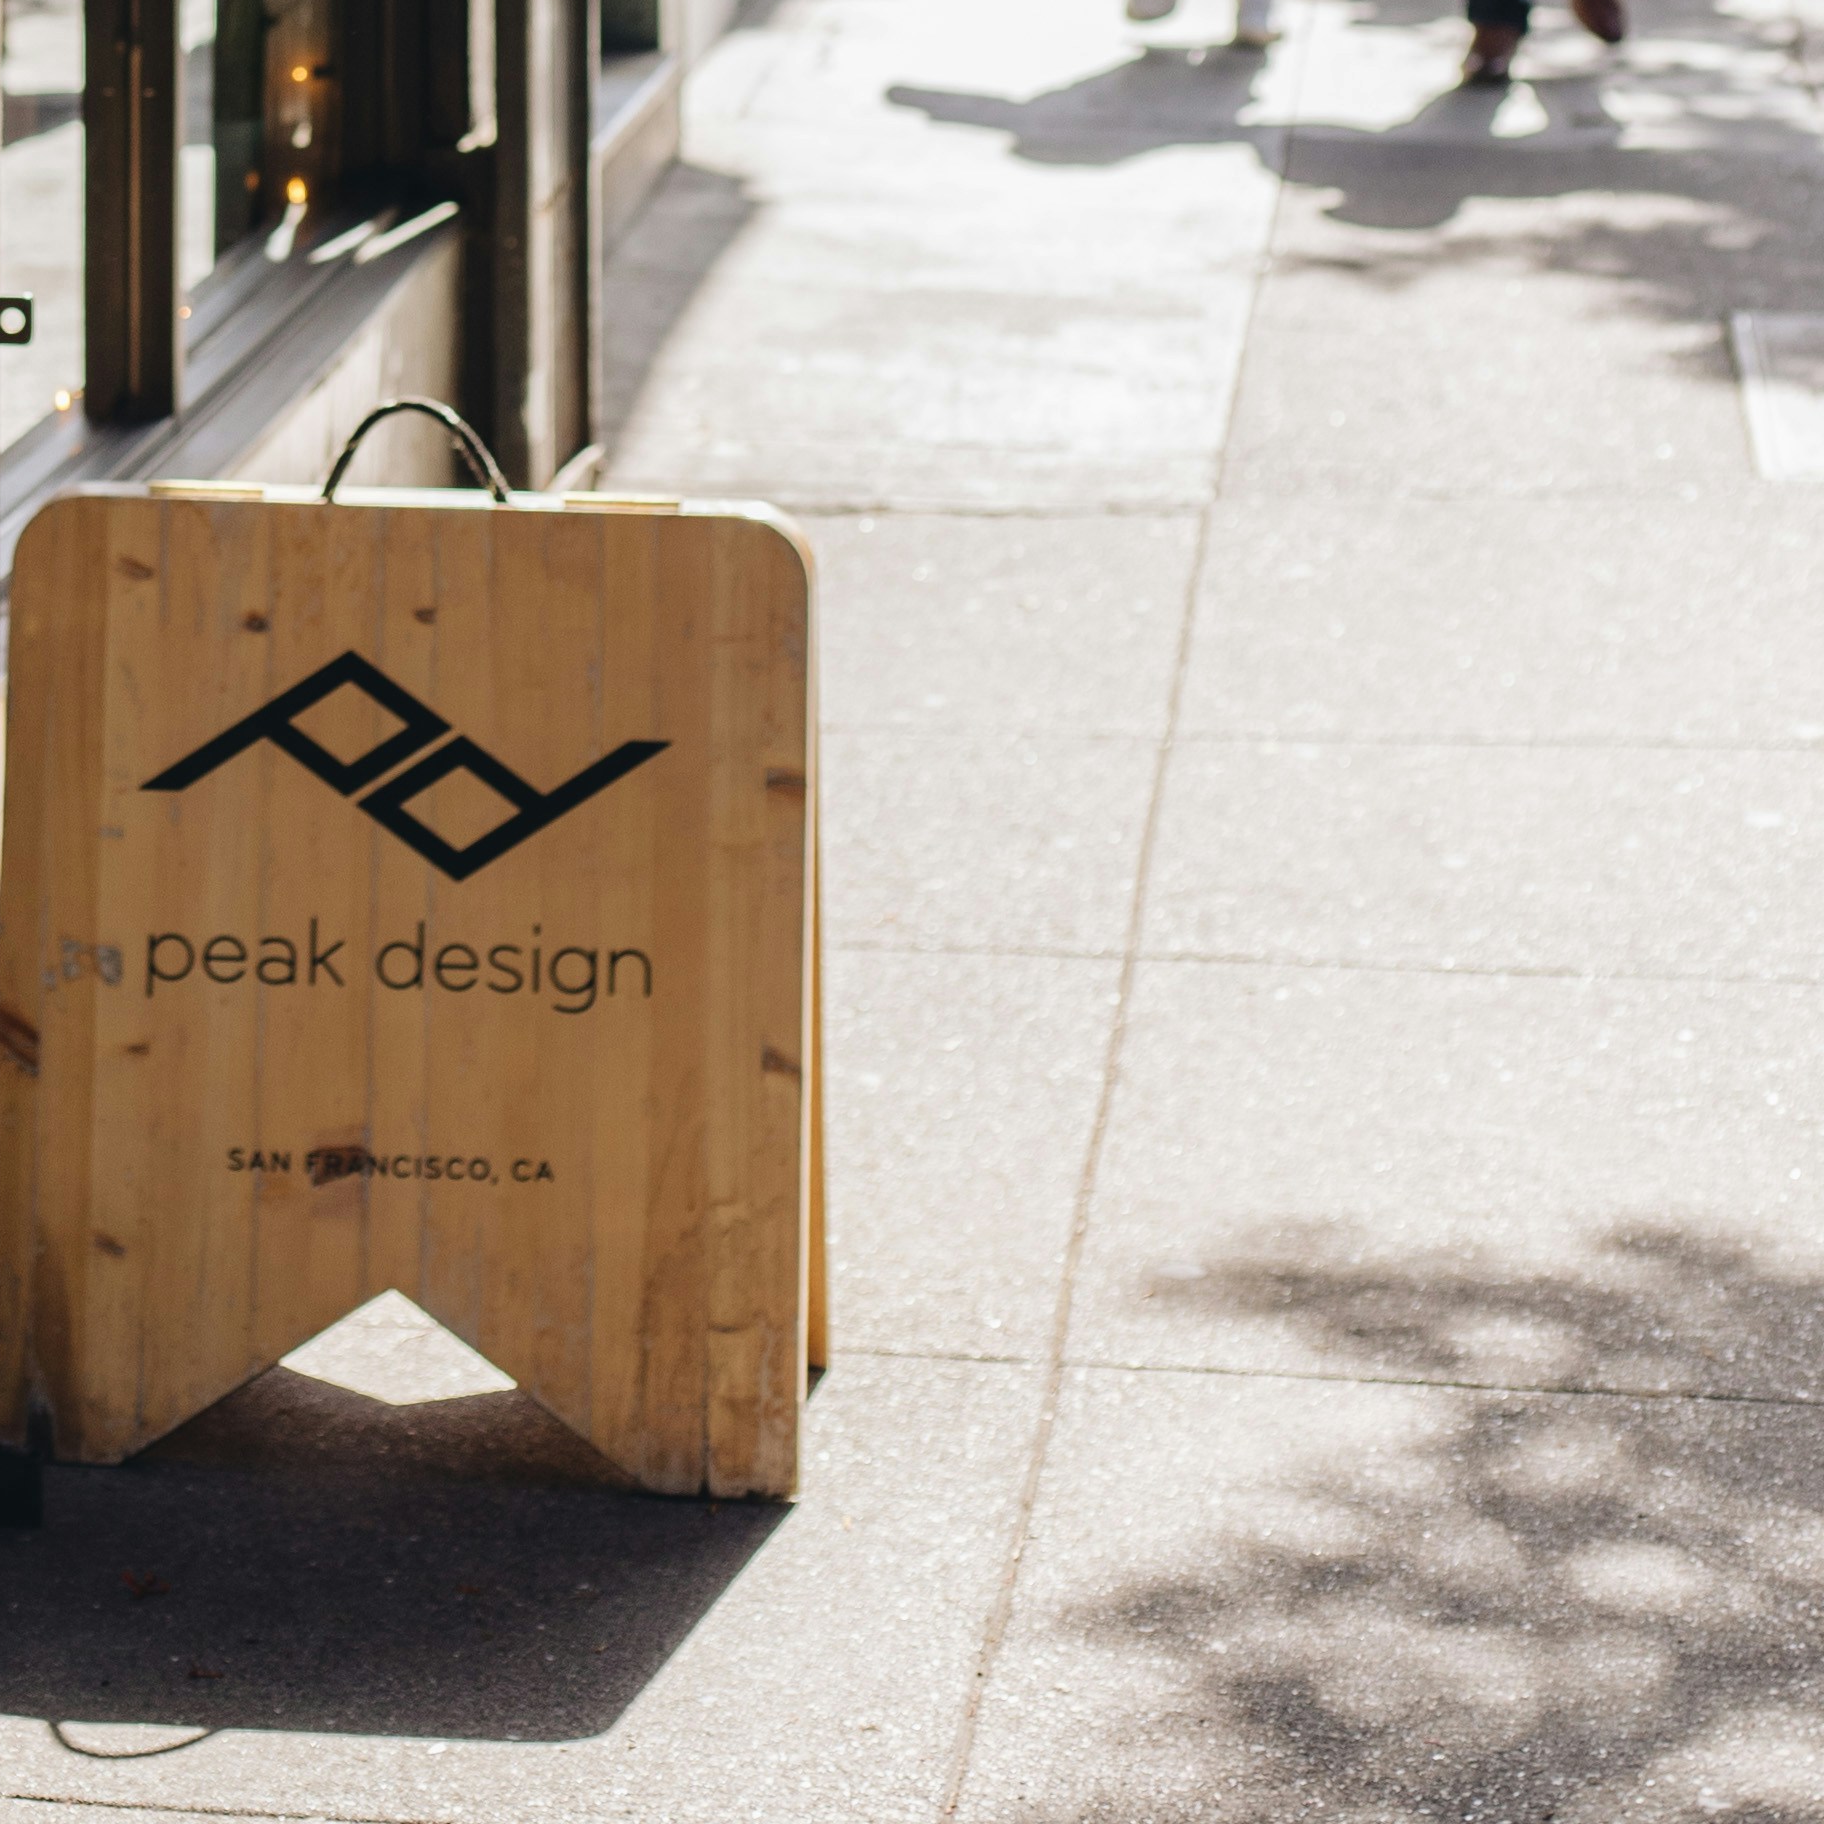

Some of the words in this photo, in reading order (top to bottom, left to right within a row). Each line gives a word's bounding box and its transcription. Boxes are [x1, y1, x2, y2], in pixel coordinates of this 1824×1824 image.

[144, 915, 347, 1000] peak
[375, 918, 654, 1016] design
[226, 1146, 292, 1175] SAN
[304, 1148, 500, 1187] FRANCISCO,
[510, 1157, 557, 1184] CA
